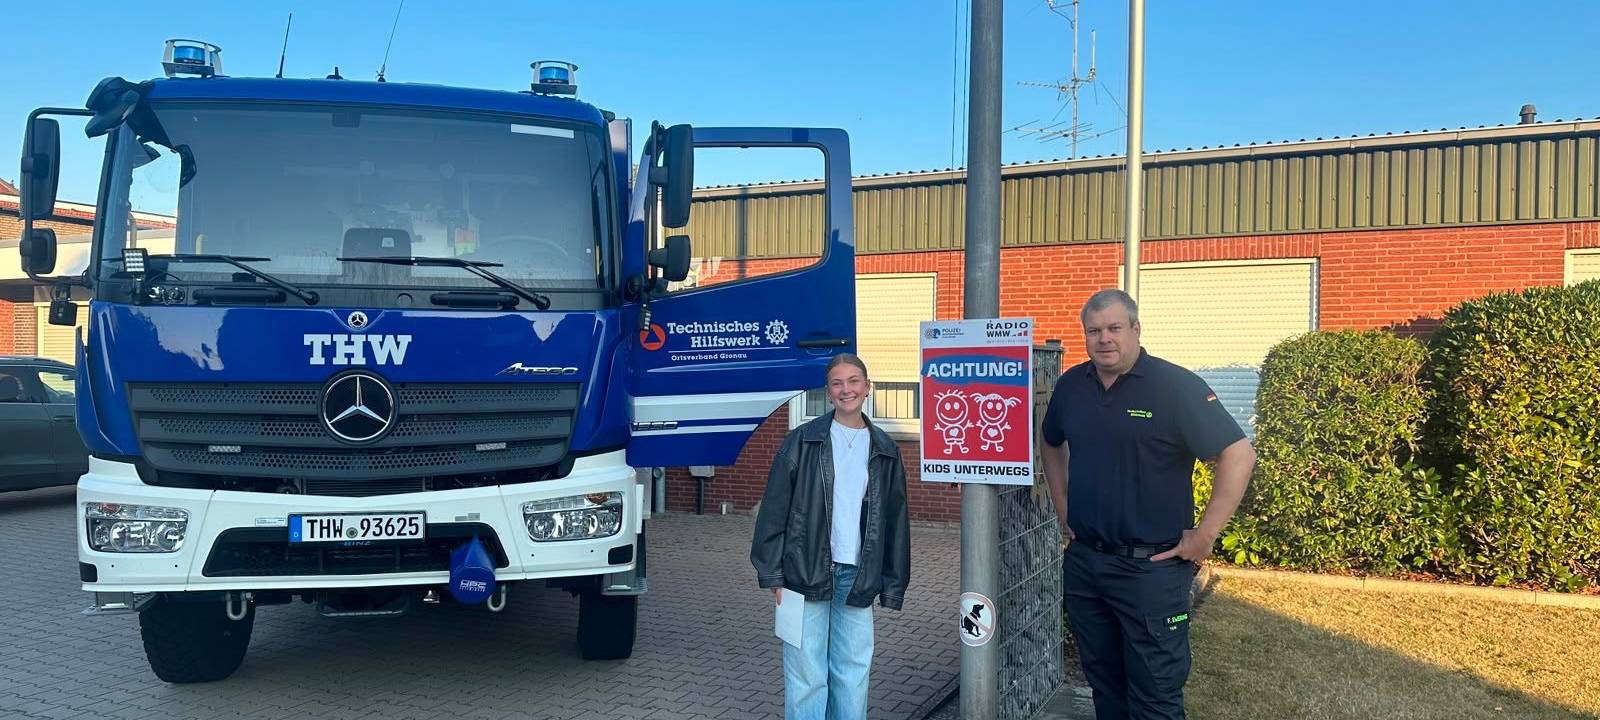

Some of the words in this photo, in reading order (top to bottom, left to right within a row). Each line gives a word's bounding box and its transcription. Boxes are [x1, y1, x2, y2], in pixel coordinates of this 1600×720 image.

[667, 320, 760, 335] Technisches
[986, 321, 1029, 330] RADIO
[986, 330, 1011, 338] WMW
[690, 335, 761, 348] Hilfswerk
[303, 334, 412, 365] THW
[671, 353, 718, 361] Ortsverband
[720, 352, 748, 360] Gronau
[926, 361, 1023, 378] ACHTUNG!
[923, 463, 951, 473] KIDS
[954, 465, 1030, 477] UNTERWEGS
[307, 518, 344, 539] THW
[360, 516, 419, 537] 93625
